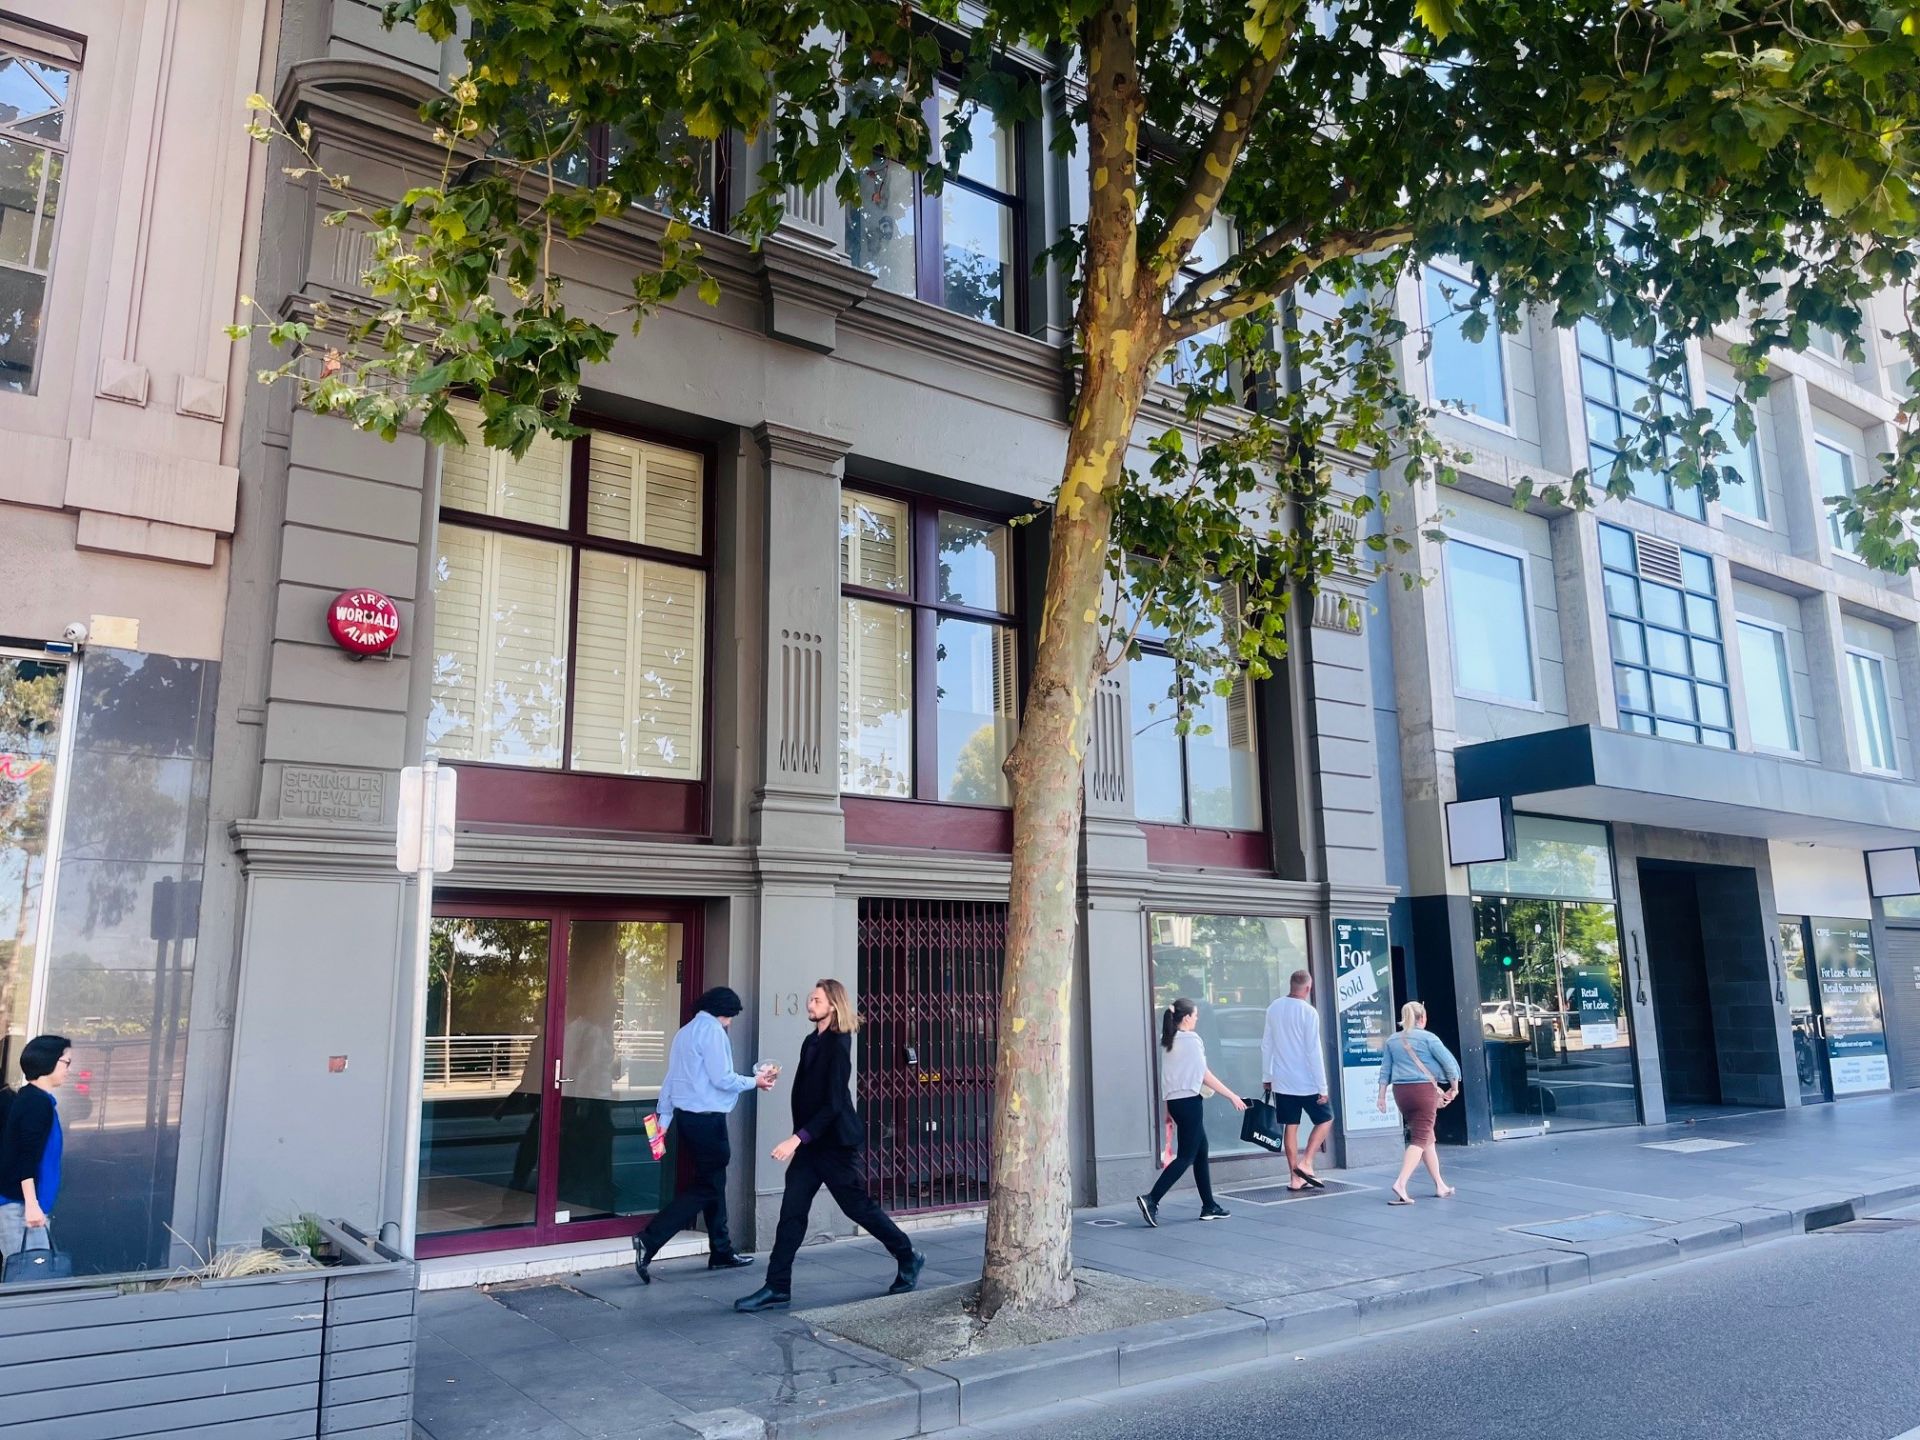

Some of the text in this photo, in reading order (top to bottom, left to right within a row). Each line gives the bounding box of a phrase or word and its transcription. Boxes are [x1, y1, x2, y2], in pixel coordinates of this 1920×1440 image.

[350, 594, 387, 610] FIRE
[336, 606, 399, 629] WORMALD
[343, 626, 388, 645] ALARM
[285, 772, 381, 792] SPRINKLER
[1339, 943, 1372, 969] For
[1830, 967, 1845, 978] Lease
[1339, 976, 1365, 1001] Sold
[1580, 987, 1599, 998] Retail
[1838, 983, 1853, 996] Space
[1582, 1000, 1610, 1010] For Lease
